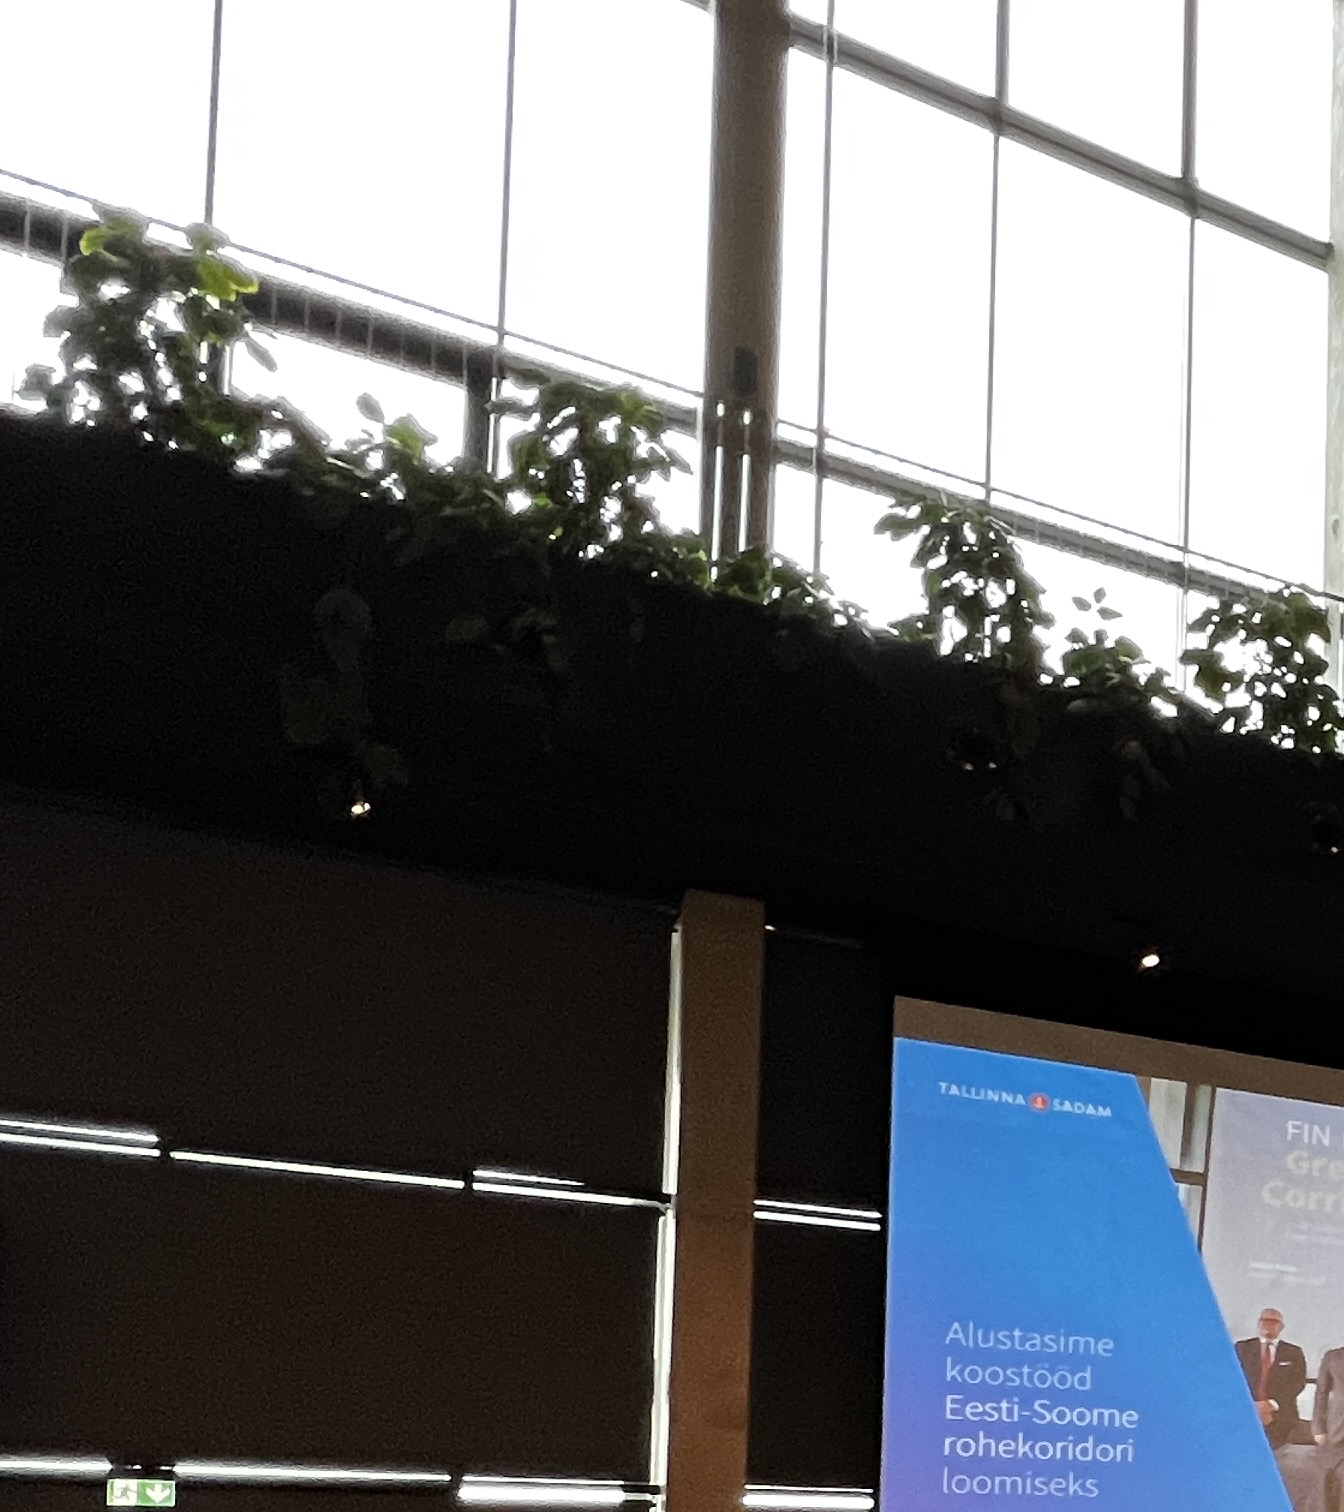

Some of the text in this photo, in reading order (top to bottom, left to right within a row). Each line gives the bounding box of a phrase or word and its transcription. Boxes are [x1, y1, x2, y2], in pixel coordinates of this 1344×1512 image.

[938, 1081, 1112, 1118] TALLINNA SADAM
[1286, 1120, 1331, 1147] FIN
[945, 1320, 1115, 1357] Alustasime
[946, 1356, 1092, 1391] koostööd
[945, 1394, 1140, 1429] Eesti-Soome
[943, 1430, 1134, 1463] rohekoridori
[942, 1466, 1100, 1498] loomiseks
